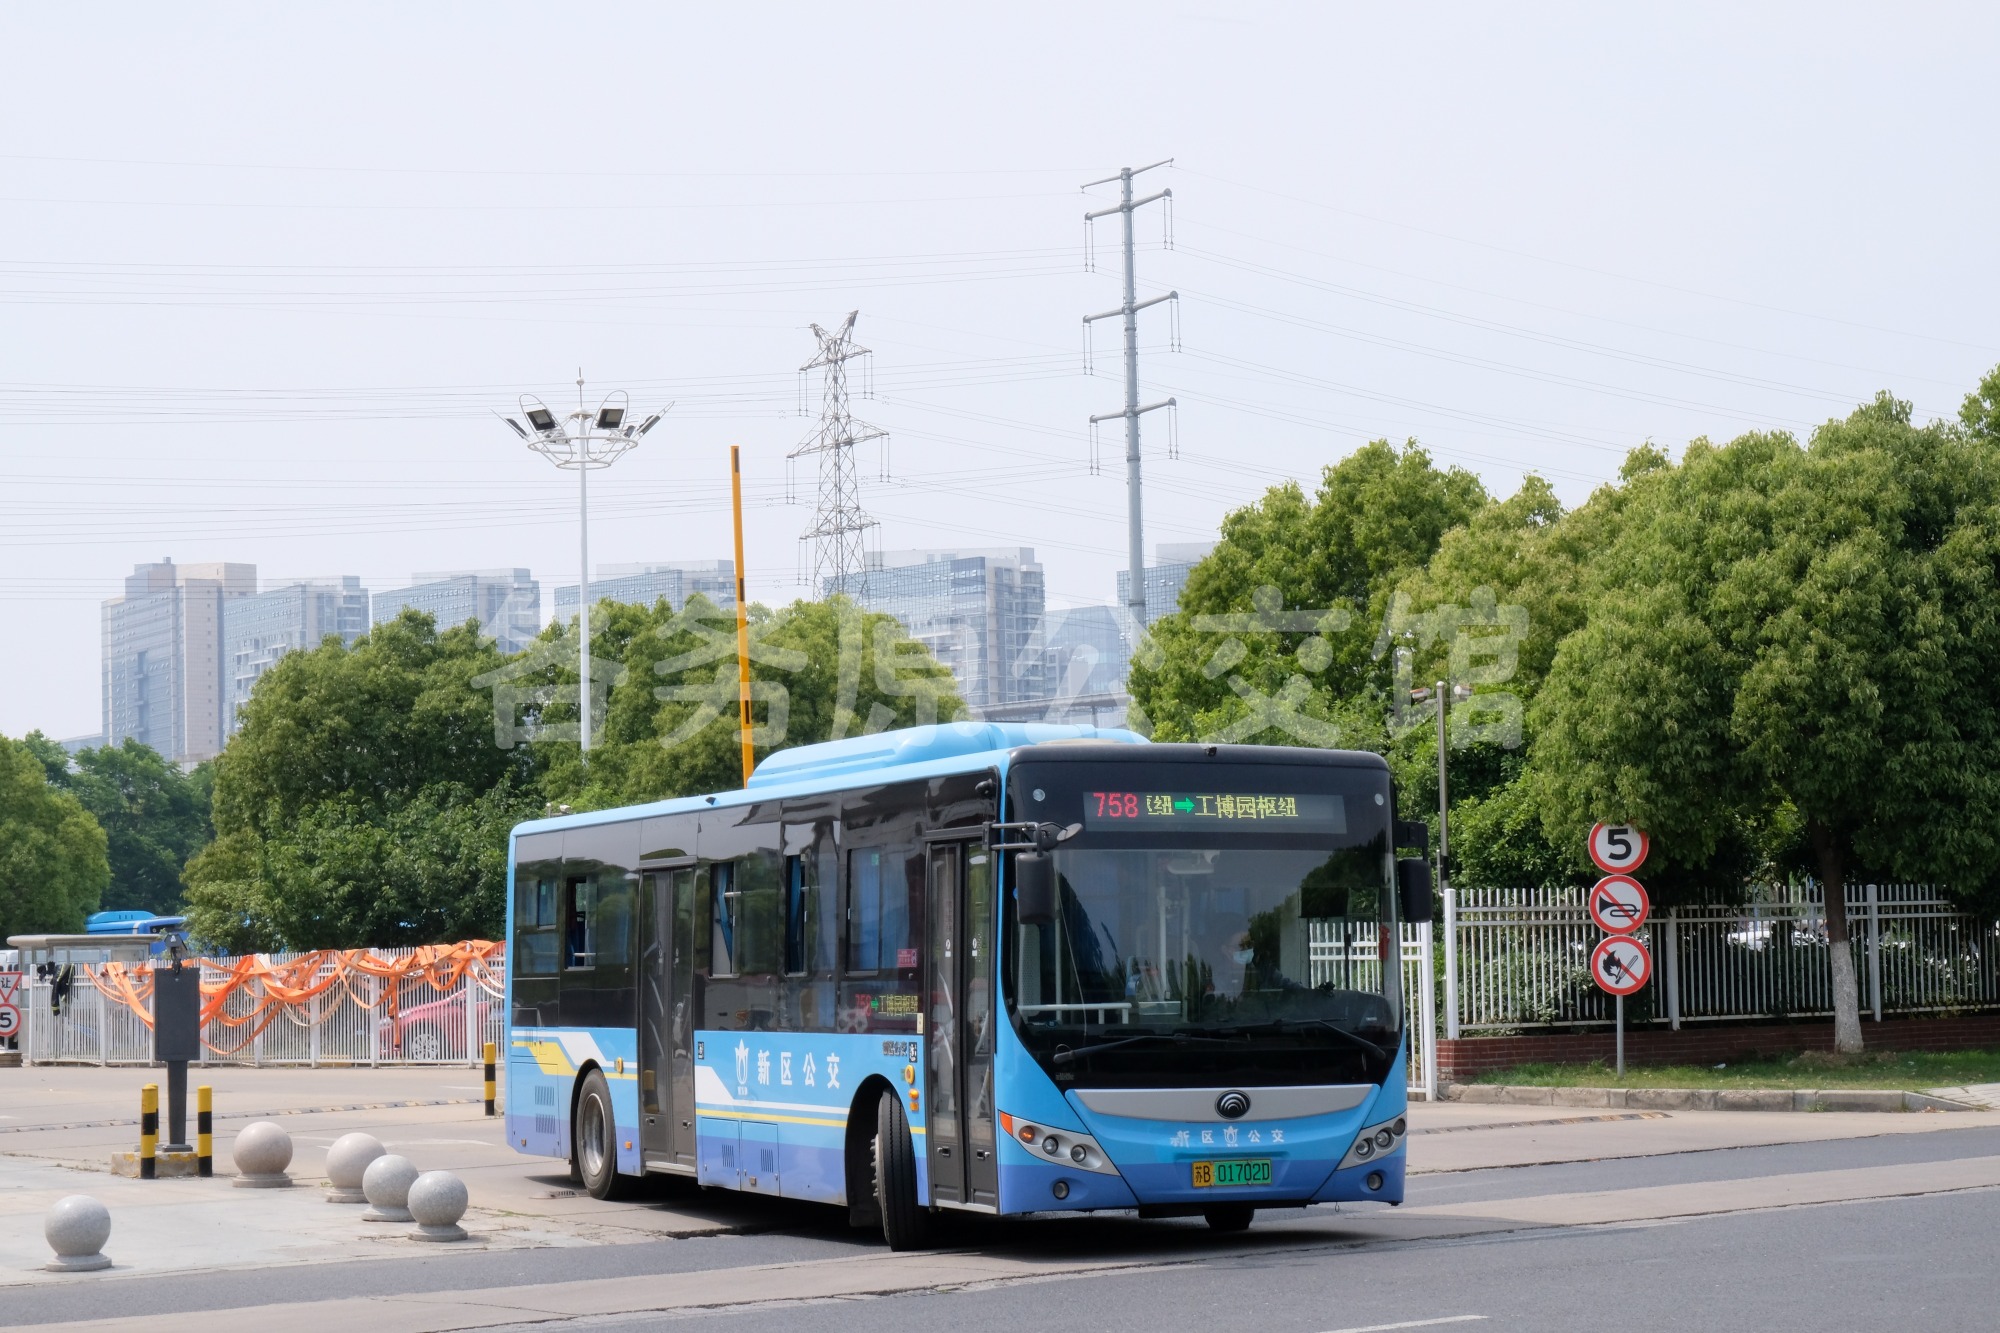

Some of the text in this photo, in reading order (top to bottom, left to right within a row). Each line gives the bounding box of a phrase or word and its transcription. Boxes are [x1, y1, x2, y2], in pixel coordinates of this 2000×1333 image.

[1093, 792, 1138, 818] 758
[1195, 794, 1299, 819] 工博园枢纽
[1607, 828, 1632, 860] 5
[0, 1011, 12, 1028] 5
[757, 1049, 840, 1089] 新区公交
[1170, 1129, 1285, 1148] 新区 公交
